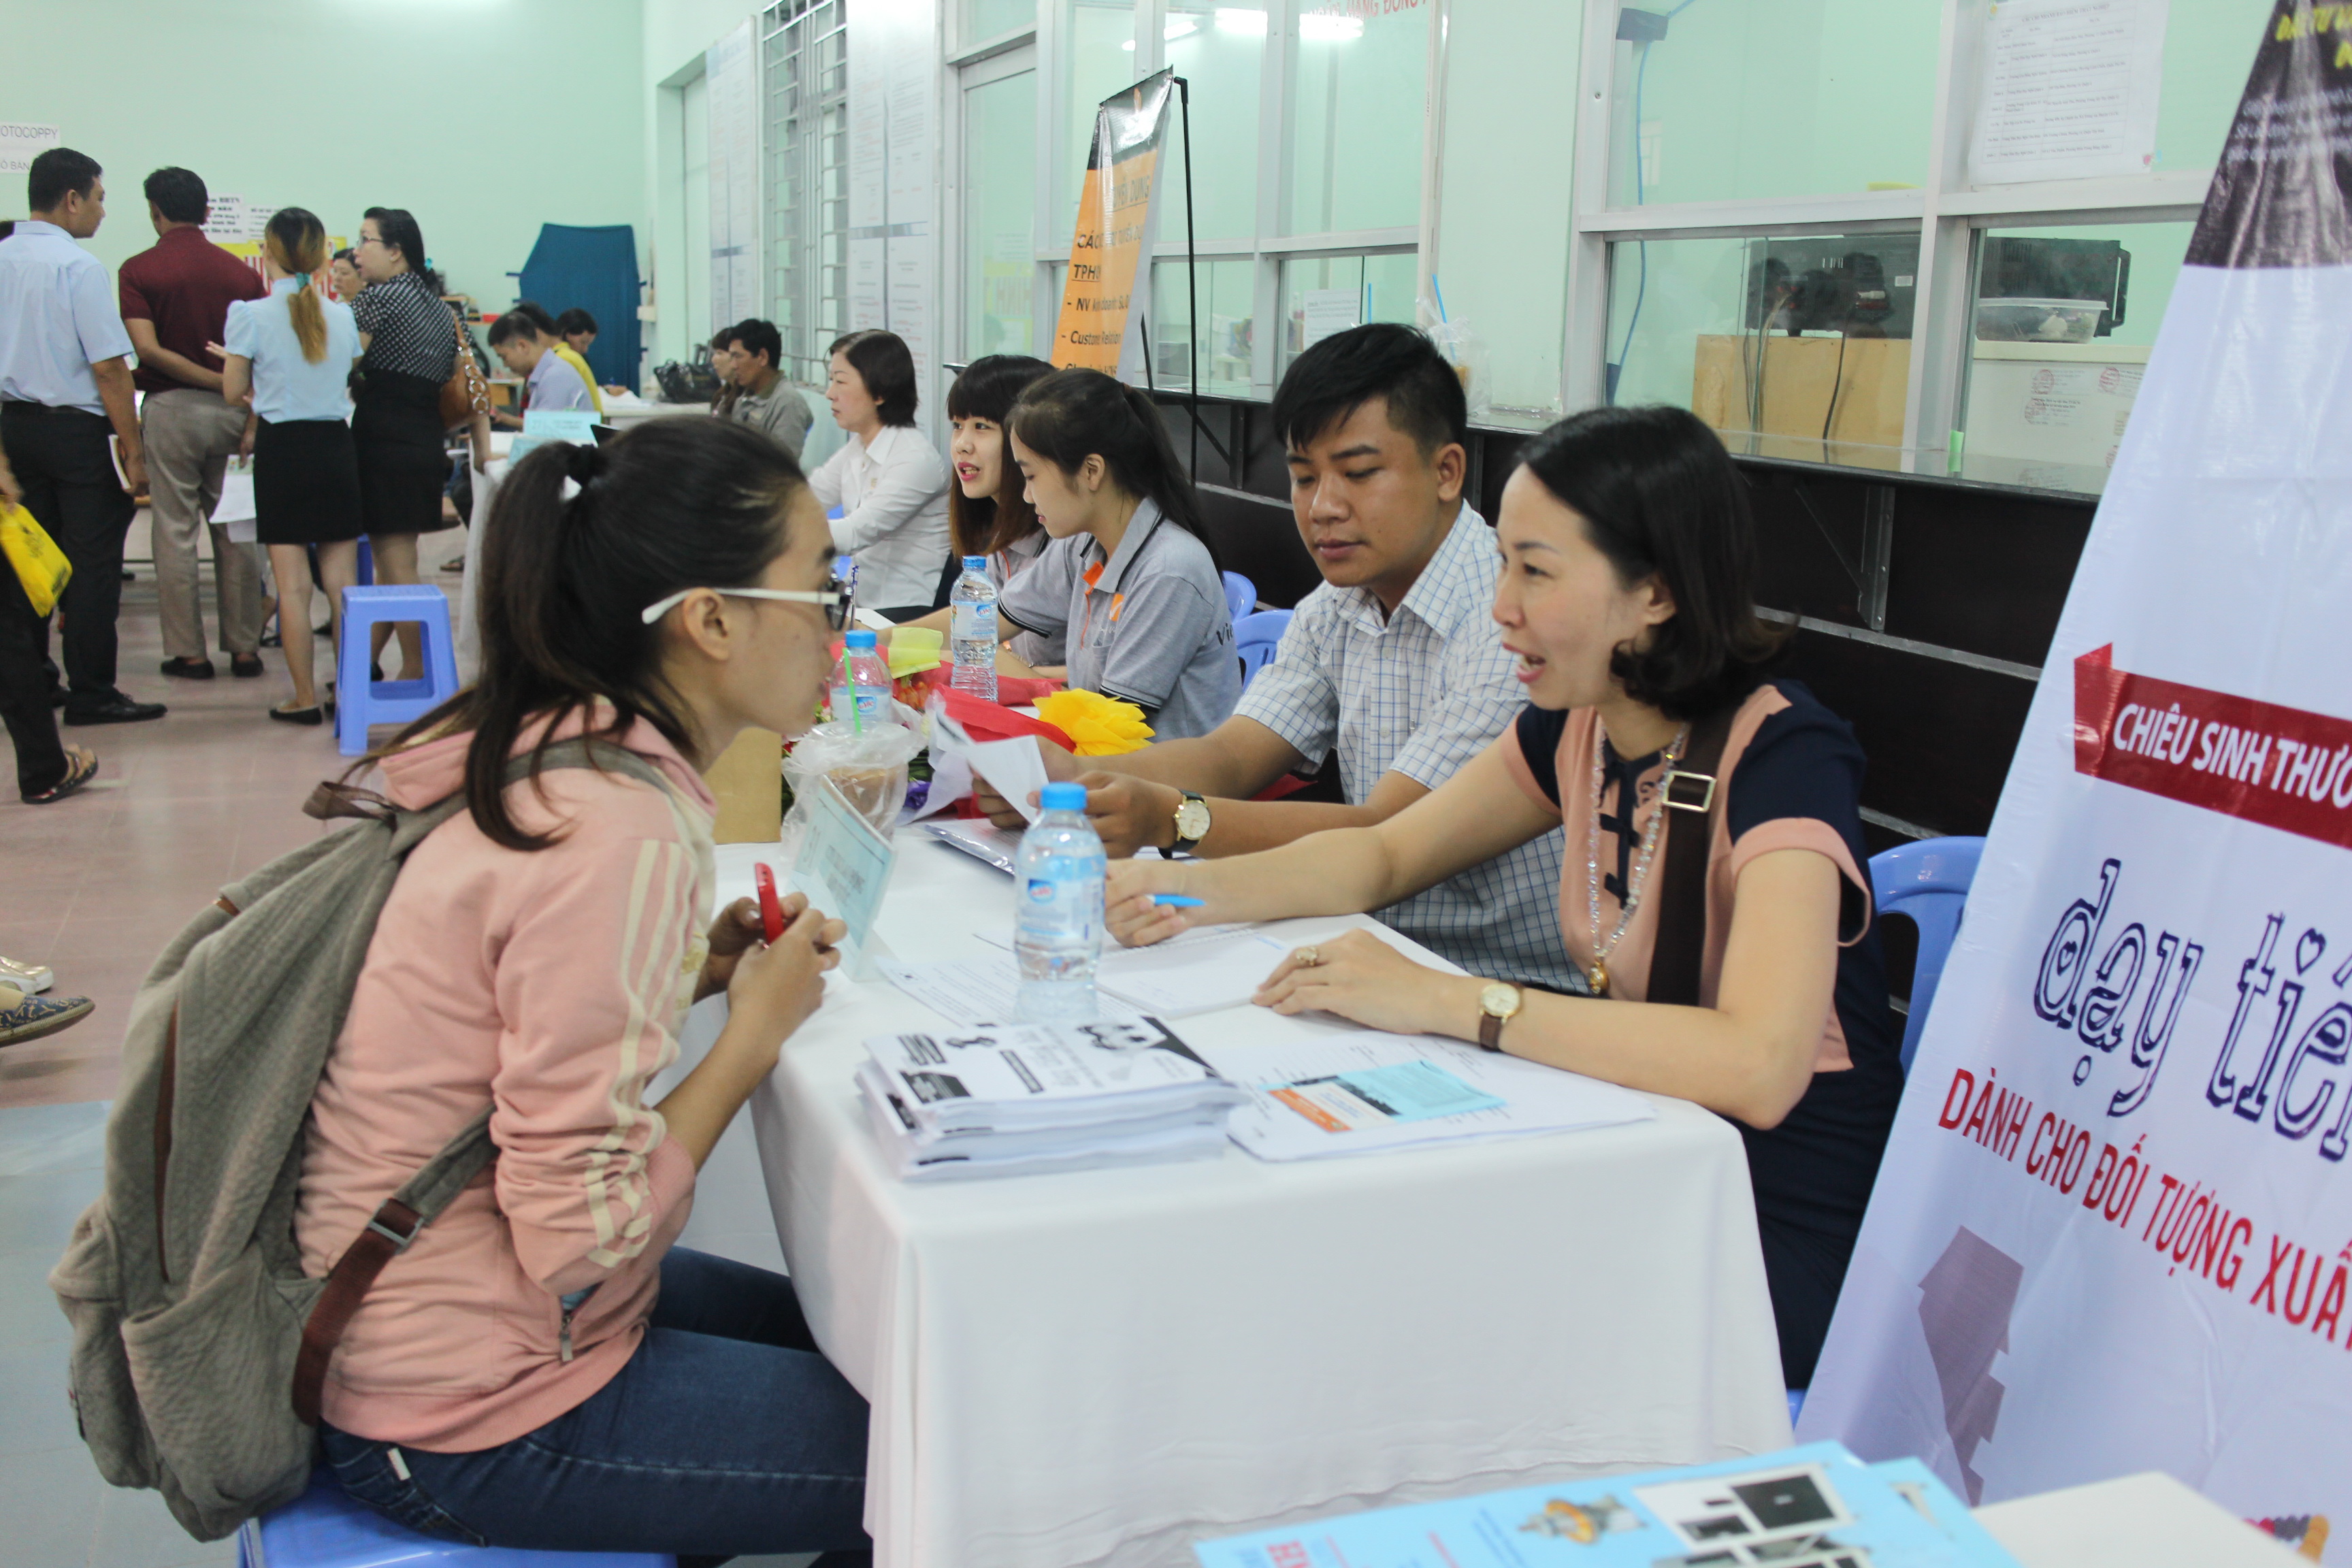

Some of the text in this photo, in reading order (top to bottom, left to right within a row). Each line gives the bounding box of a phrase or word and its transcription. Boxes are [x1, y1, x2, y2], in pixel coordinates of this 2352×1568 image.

[0, 125, 58, 140] OTOCOPPY
[2113, 702, 2199, 764] CHIÊU
[2192, 721, 2272, 785] SINH
[2034, 858, 2204, 1117] dạy
[1938, 1068, 2352, 1352] DÀNH CHO ĐỐI TƯỢNG XUẤ
